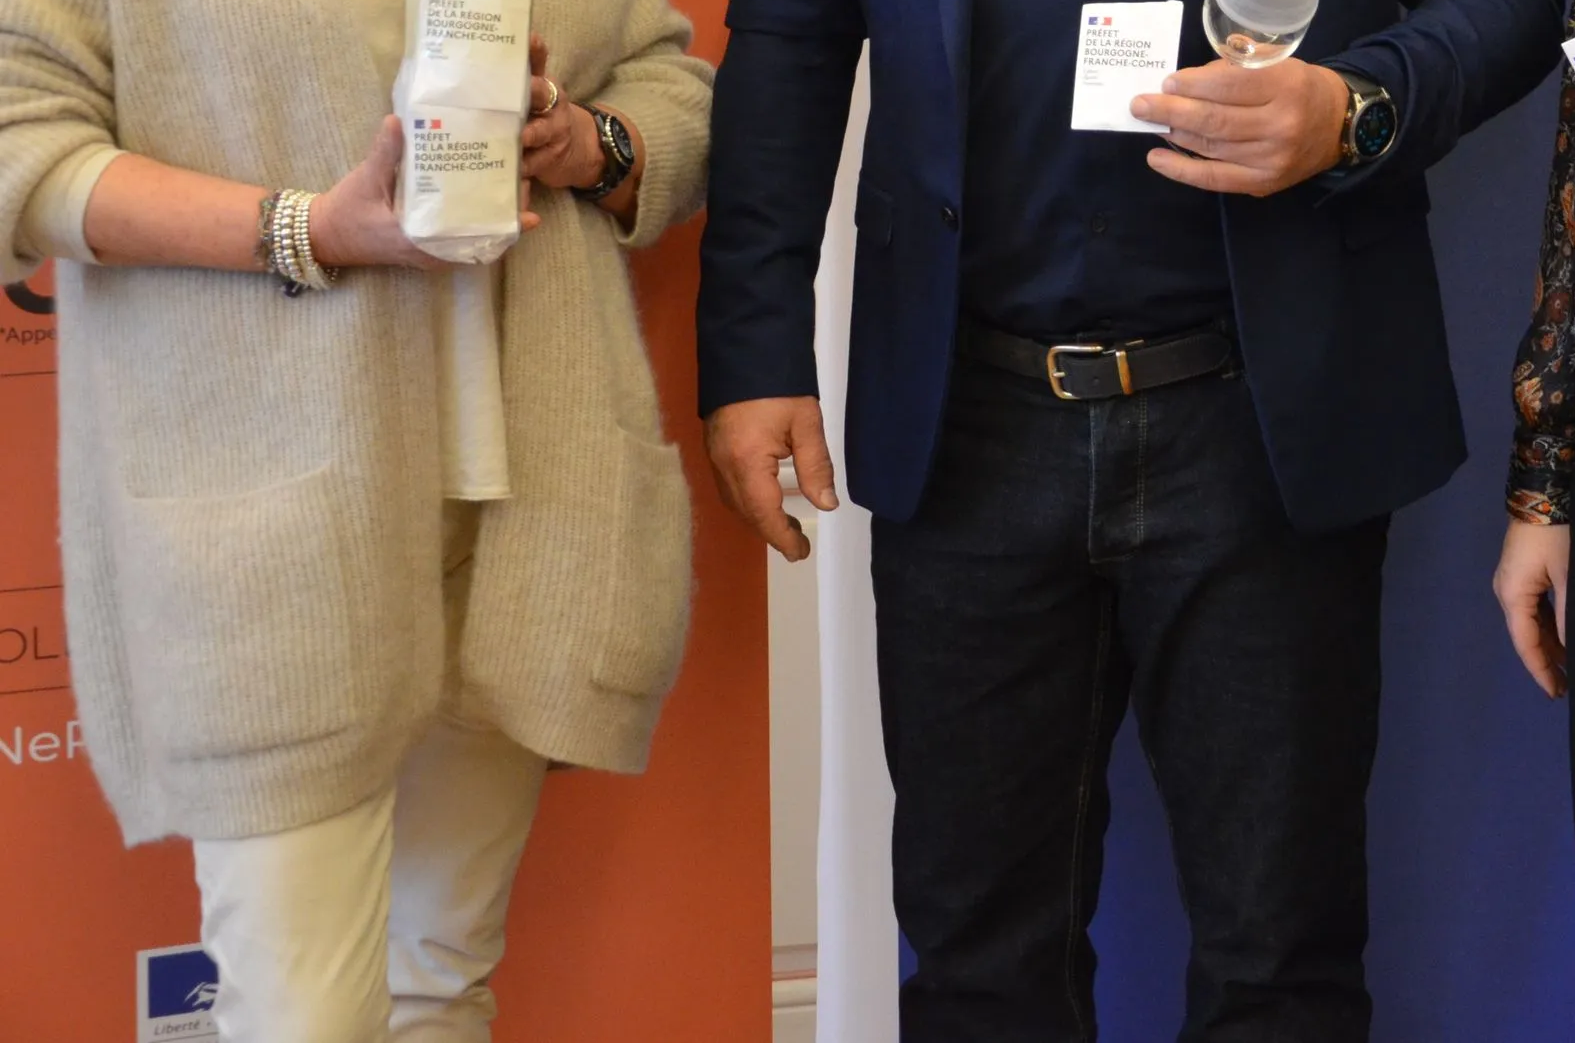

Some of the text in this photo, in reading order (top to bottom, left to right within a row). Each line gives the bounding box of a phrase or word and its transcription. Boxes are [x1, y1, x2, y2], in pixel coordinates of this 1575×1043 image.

[1085, 38, 1098, 47] DE
[1100, 39, 1112, 47] LA
[415, 143, 430, 152] DE
[430, 143, 444, 152] LA
[154, 1020, 201, 1036] Liberté
